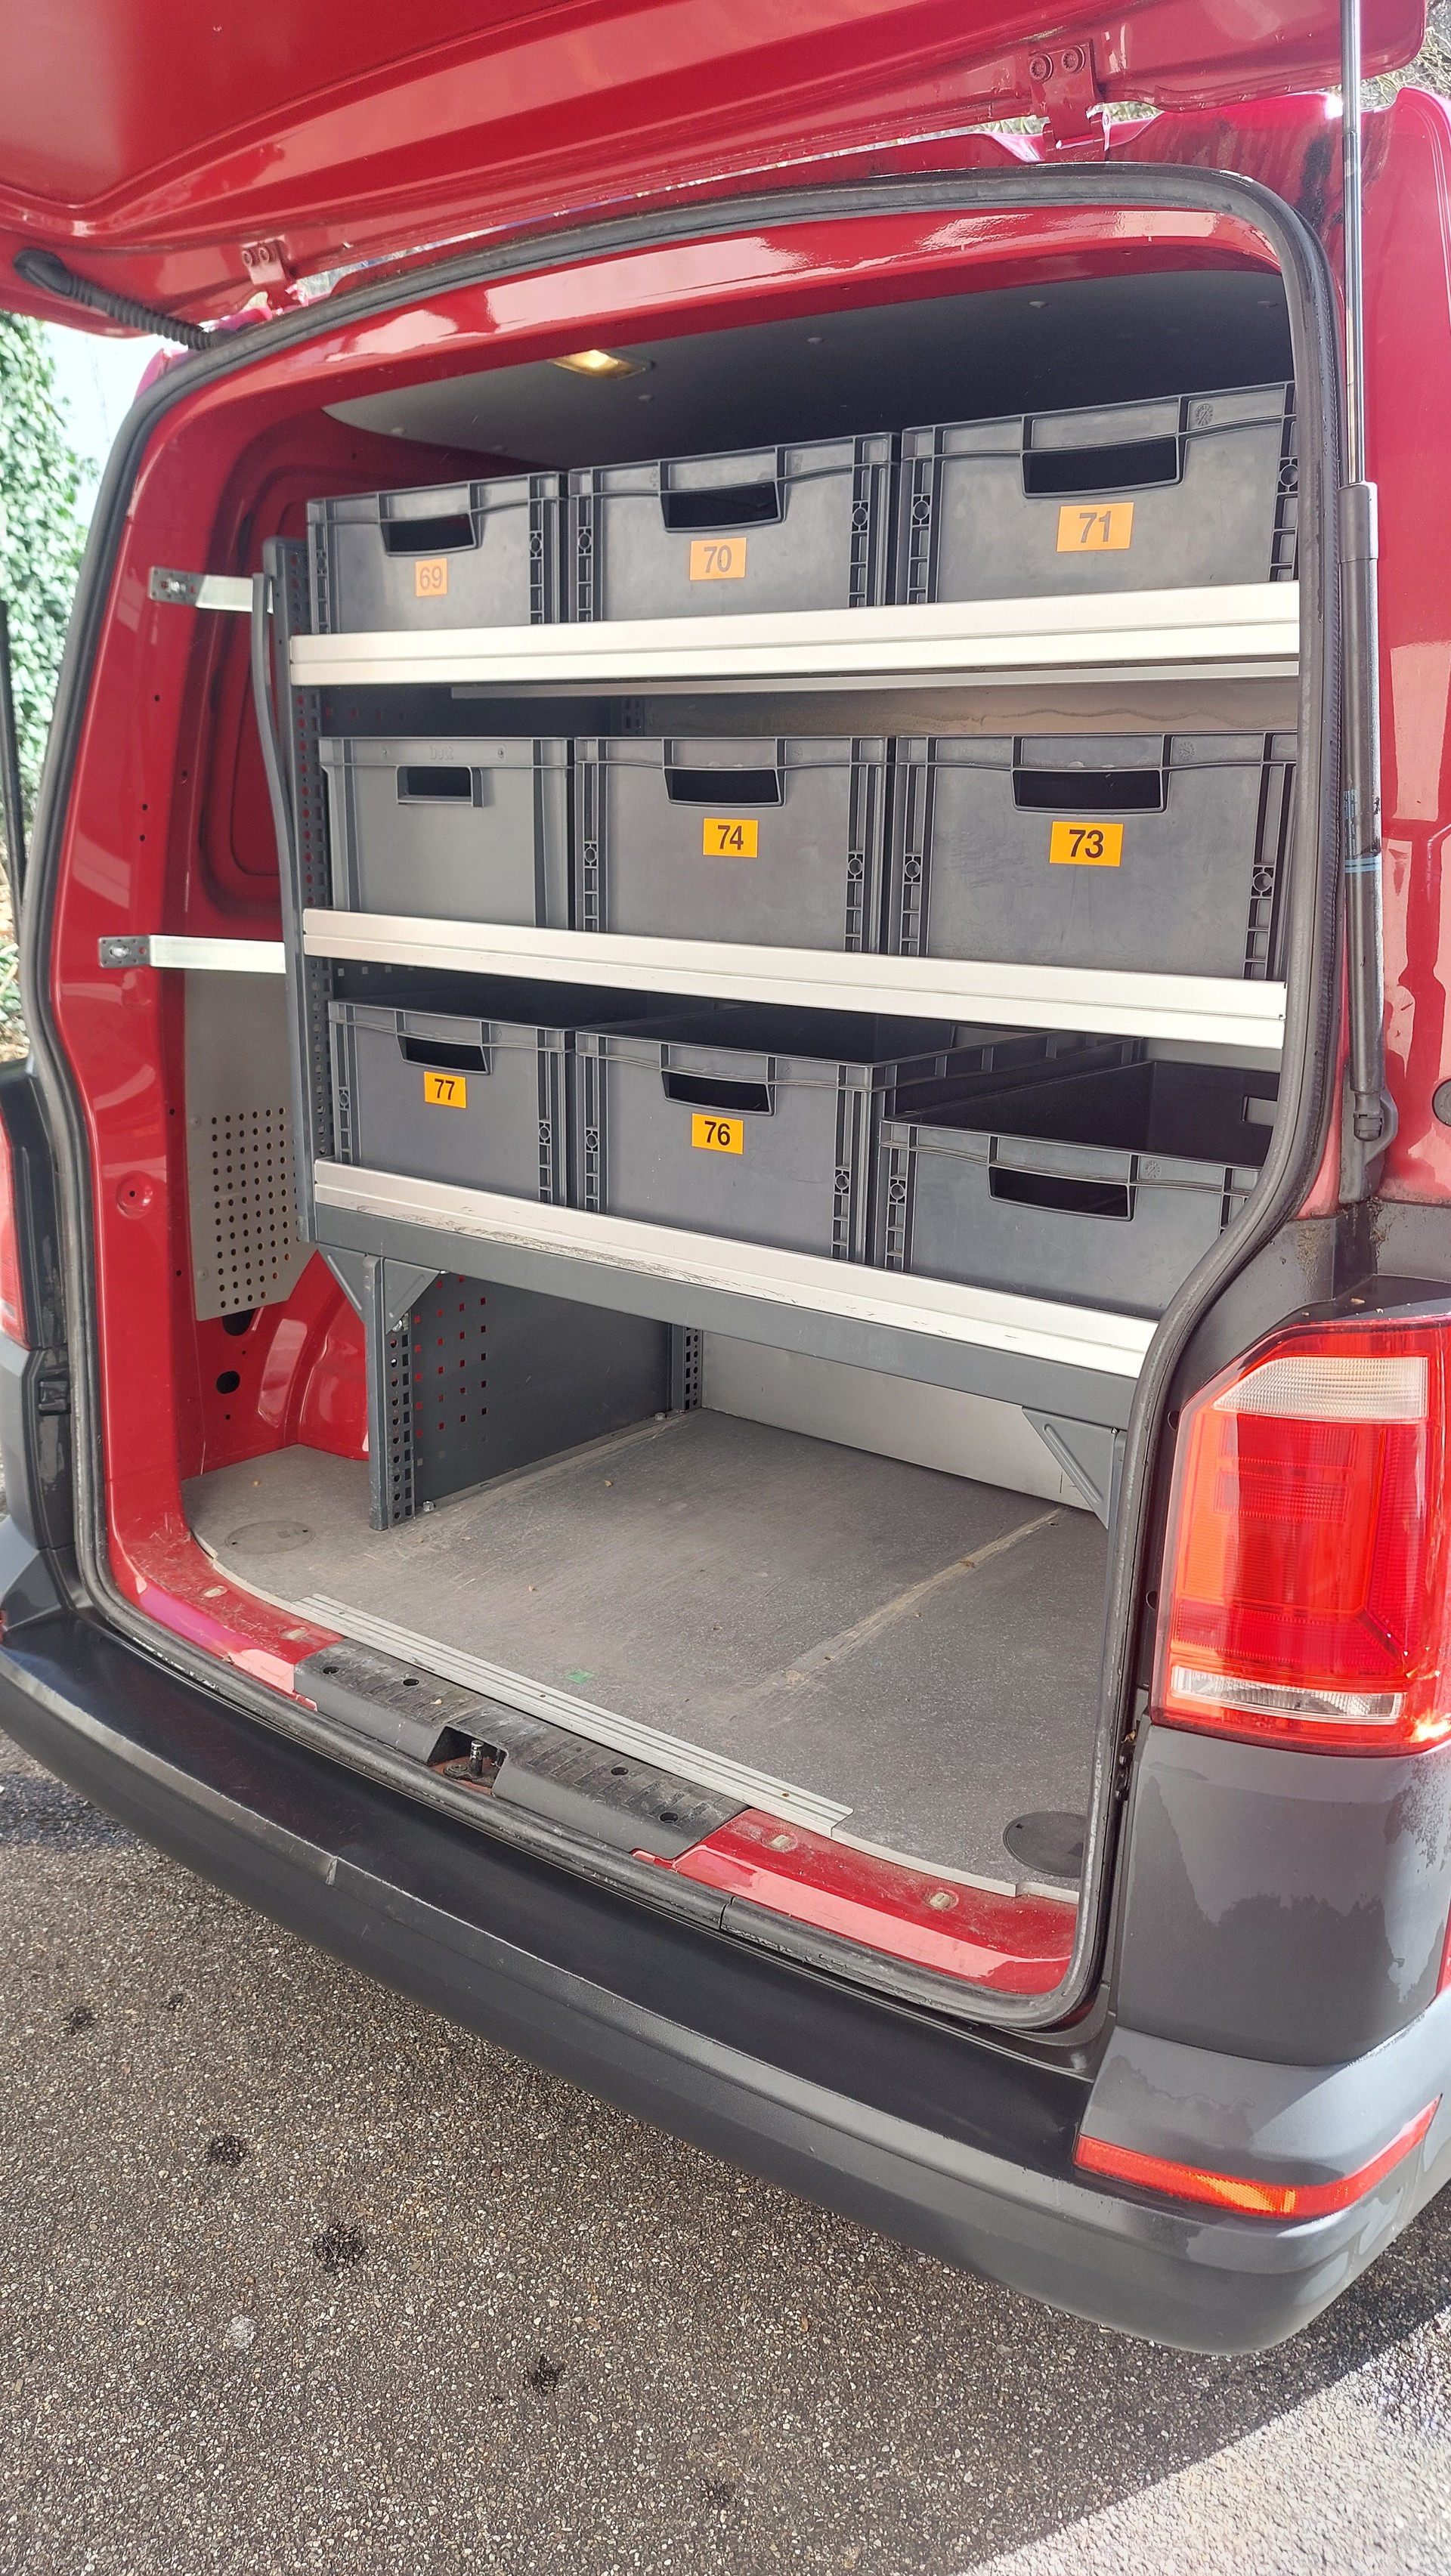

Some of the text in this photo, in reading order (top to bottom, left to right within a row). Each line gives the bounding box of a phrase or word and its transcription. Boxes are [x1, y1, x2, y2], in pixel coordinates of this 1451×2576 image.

[1079, 511, 1111, 543] 71
[704, 546, 732, 573] 70
[419, 564, 443, 589] 69
[717, 825, 744, 850] 74
[1069, 830, 1103, 858] 73
[434, 1078, 456, 1100] 77
[704, 1121, 731, 1146] 76
